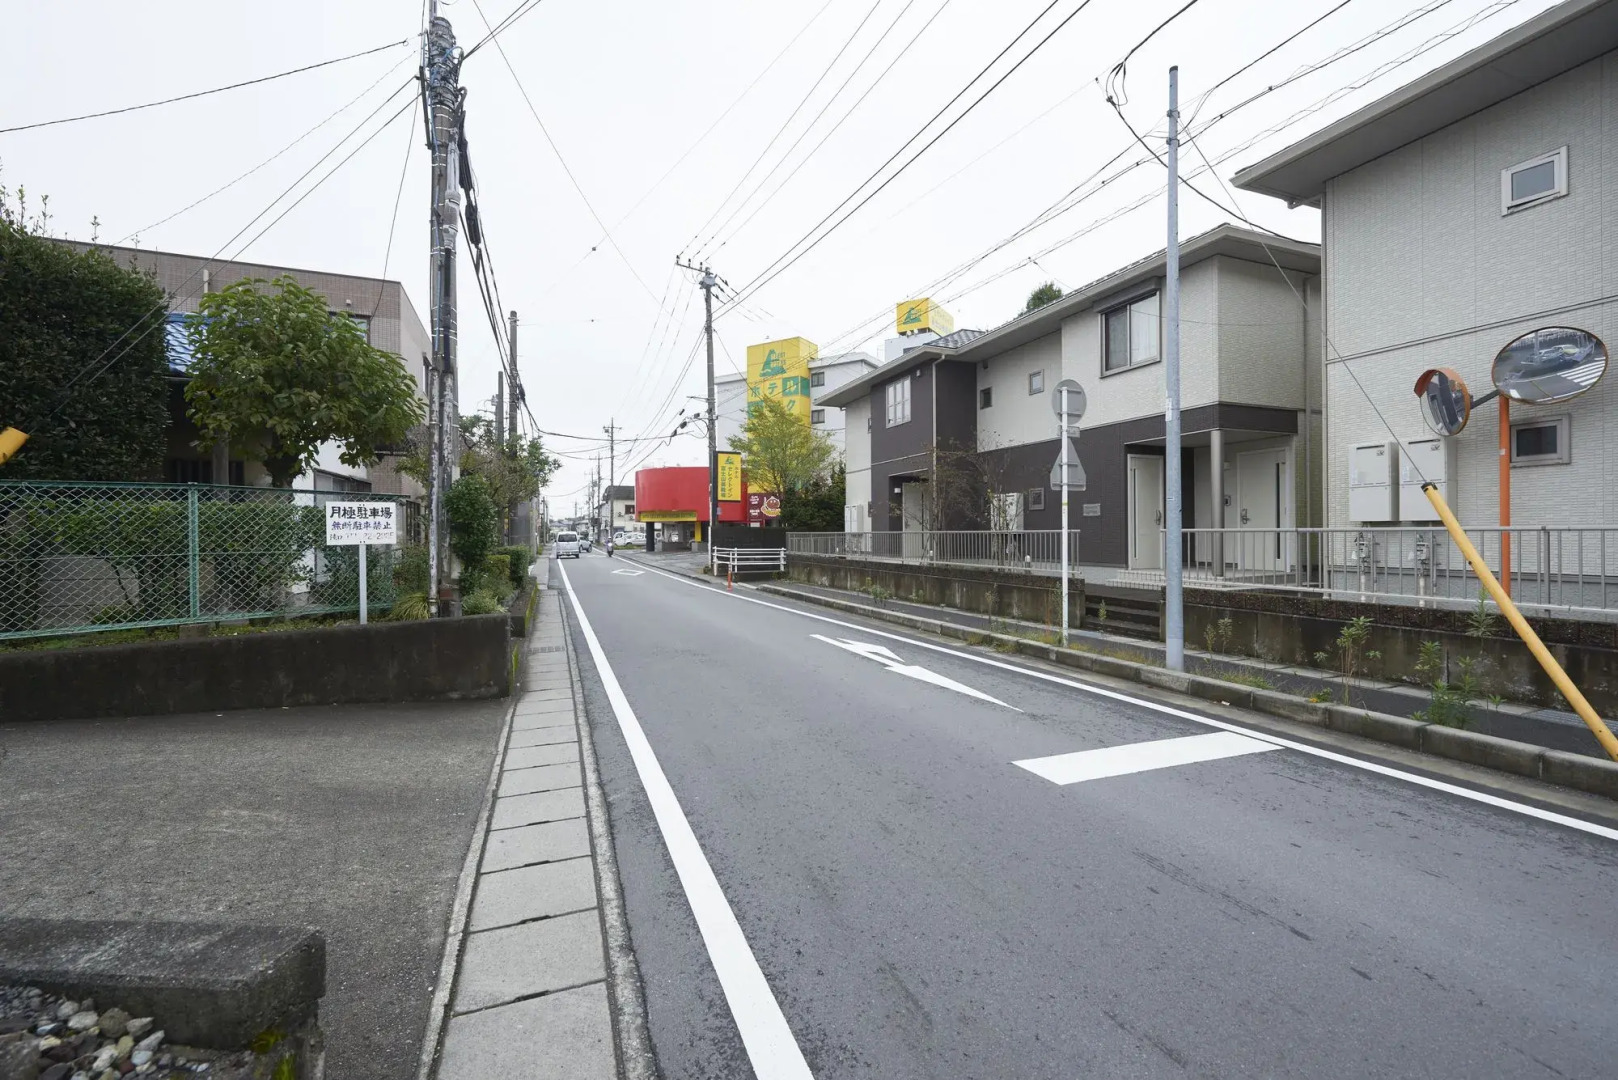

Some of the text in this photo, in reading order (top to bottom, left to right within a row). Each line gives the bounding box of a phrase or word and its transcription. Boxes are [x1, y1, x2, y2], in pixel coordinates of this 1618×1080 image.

[330, 506, 393, 519] 月極駐車場
[331, 520, 392, 531] 無断駐車禁止
